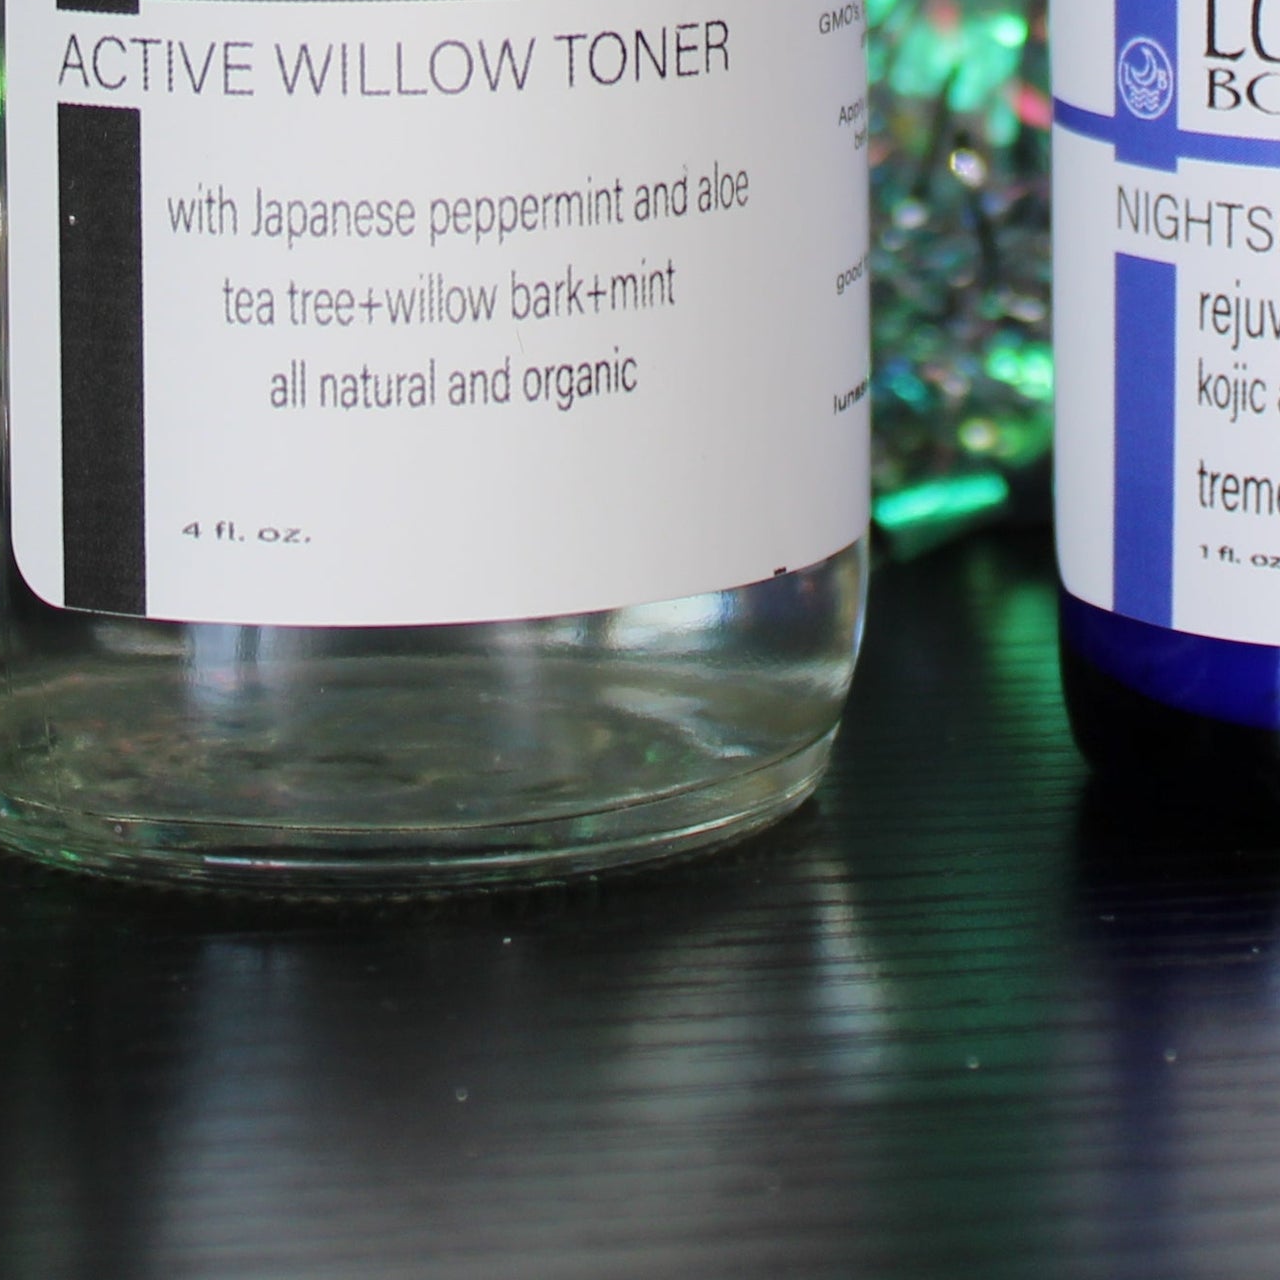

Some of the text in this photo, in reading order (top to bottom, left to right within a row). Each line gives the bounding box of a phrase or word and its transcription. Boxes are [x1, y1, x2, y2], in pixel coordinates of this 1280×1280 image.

[58, 19, 729, 96] ACTIVE WILLOW TONER
[167, 160, 748, 248] with Japanese peppermint and aloe
[222, 258, 676, 327] tea tree+willow bark+mint
[270, 346, 637, 412] all natural and organic
[1198, 357, 1267, 423] kojic
[182, 520, 310, 543] 4 fl. oz.
[1200, 544, 1208, 559] 1
[1218, 545, 1241, 564] fl.
